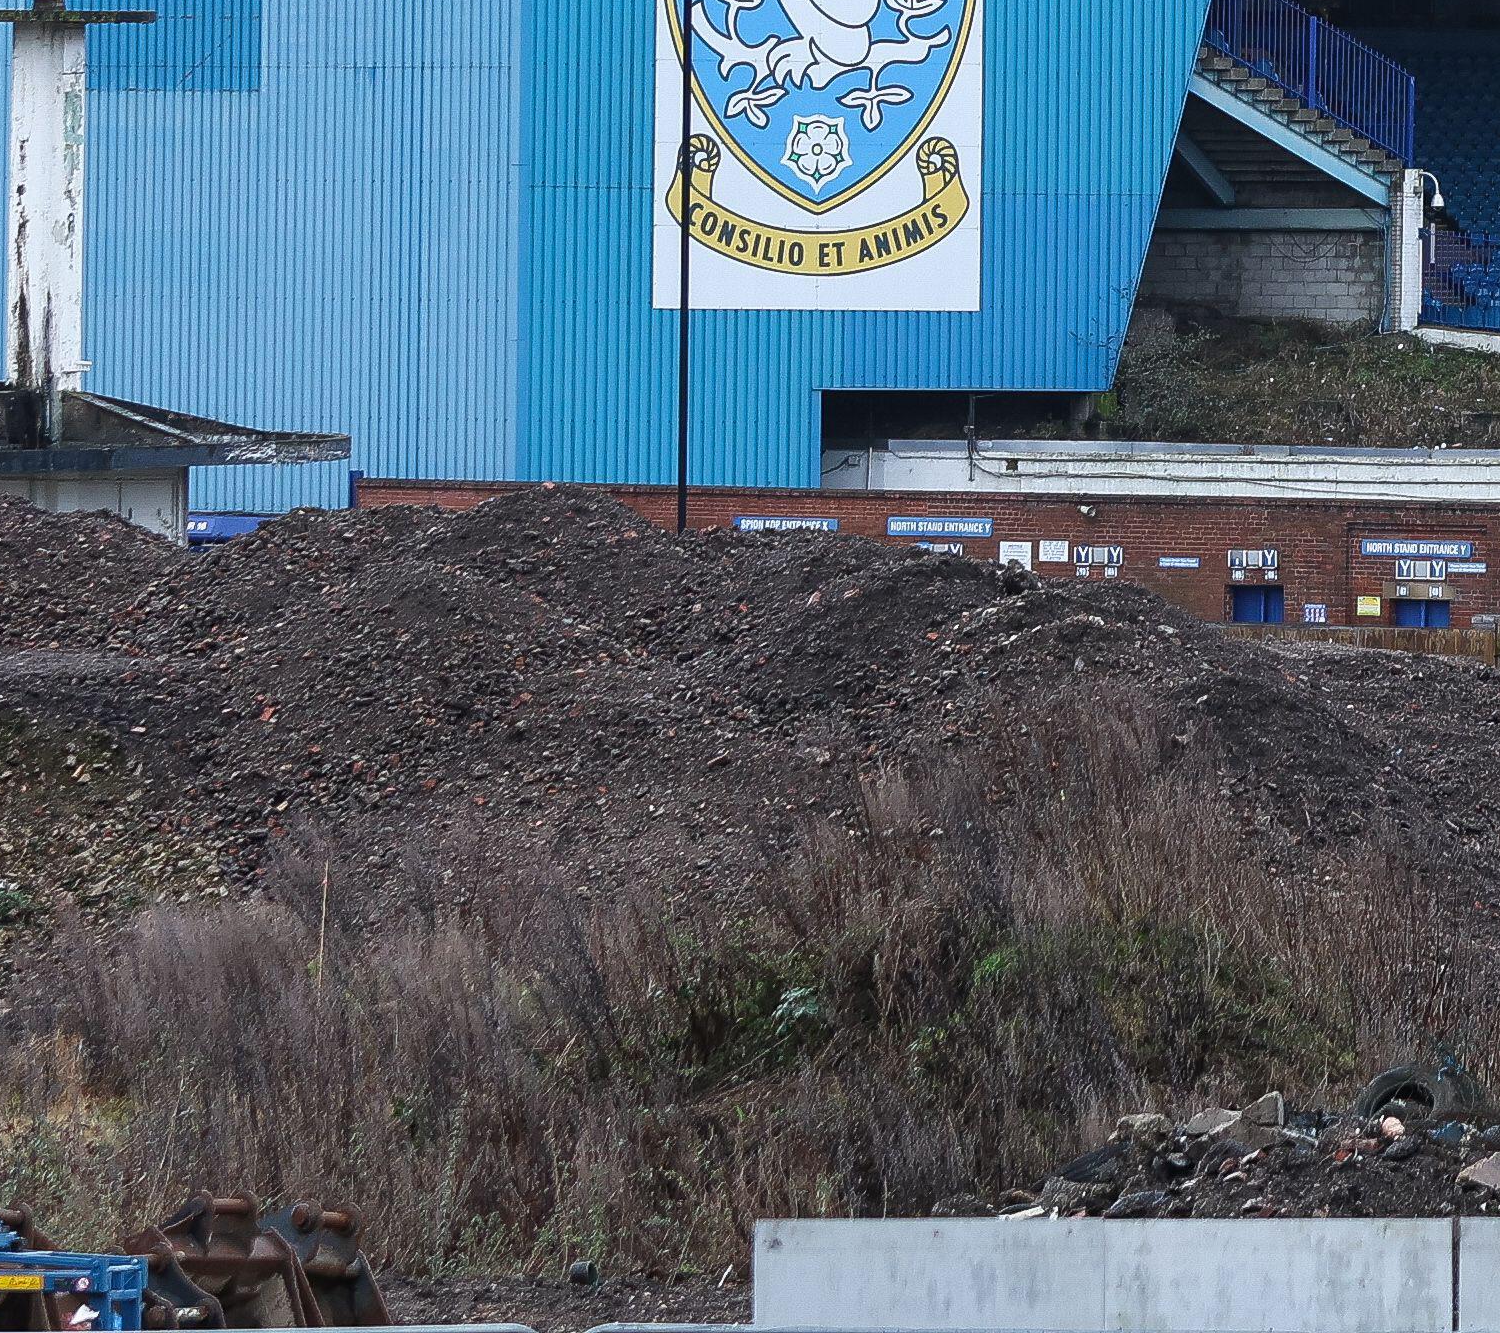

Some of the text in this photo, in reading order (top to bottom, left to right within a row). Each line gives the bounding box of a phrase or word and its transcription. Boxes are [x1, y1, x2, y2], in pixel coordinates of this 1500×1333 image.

[688, 202, 949, 267] CONSILIO ET ANIMIS
[890, 521, 992, 533] NORTH STAND ENTRANCE Y
[1077, 546, 1090, 562] Y
[1109, 546, 1122, 562] Y
[1366, 542, 1467, 554] NORTH STAND ENTRANCE Y
[1263, 549, 1276, 565] Y
[1399, 560, 1411, 576] Y
[1431, 560, 1442, 576] Y
